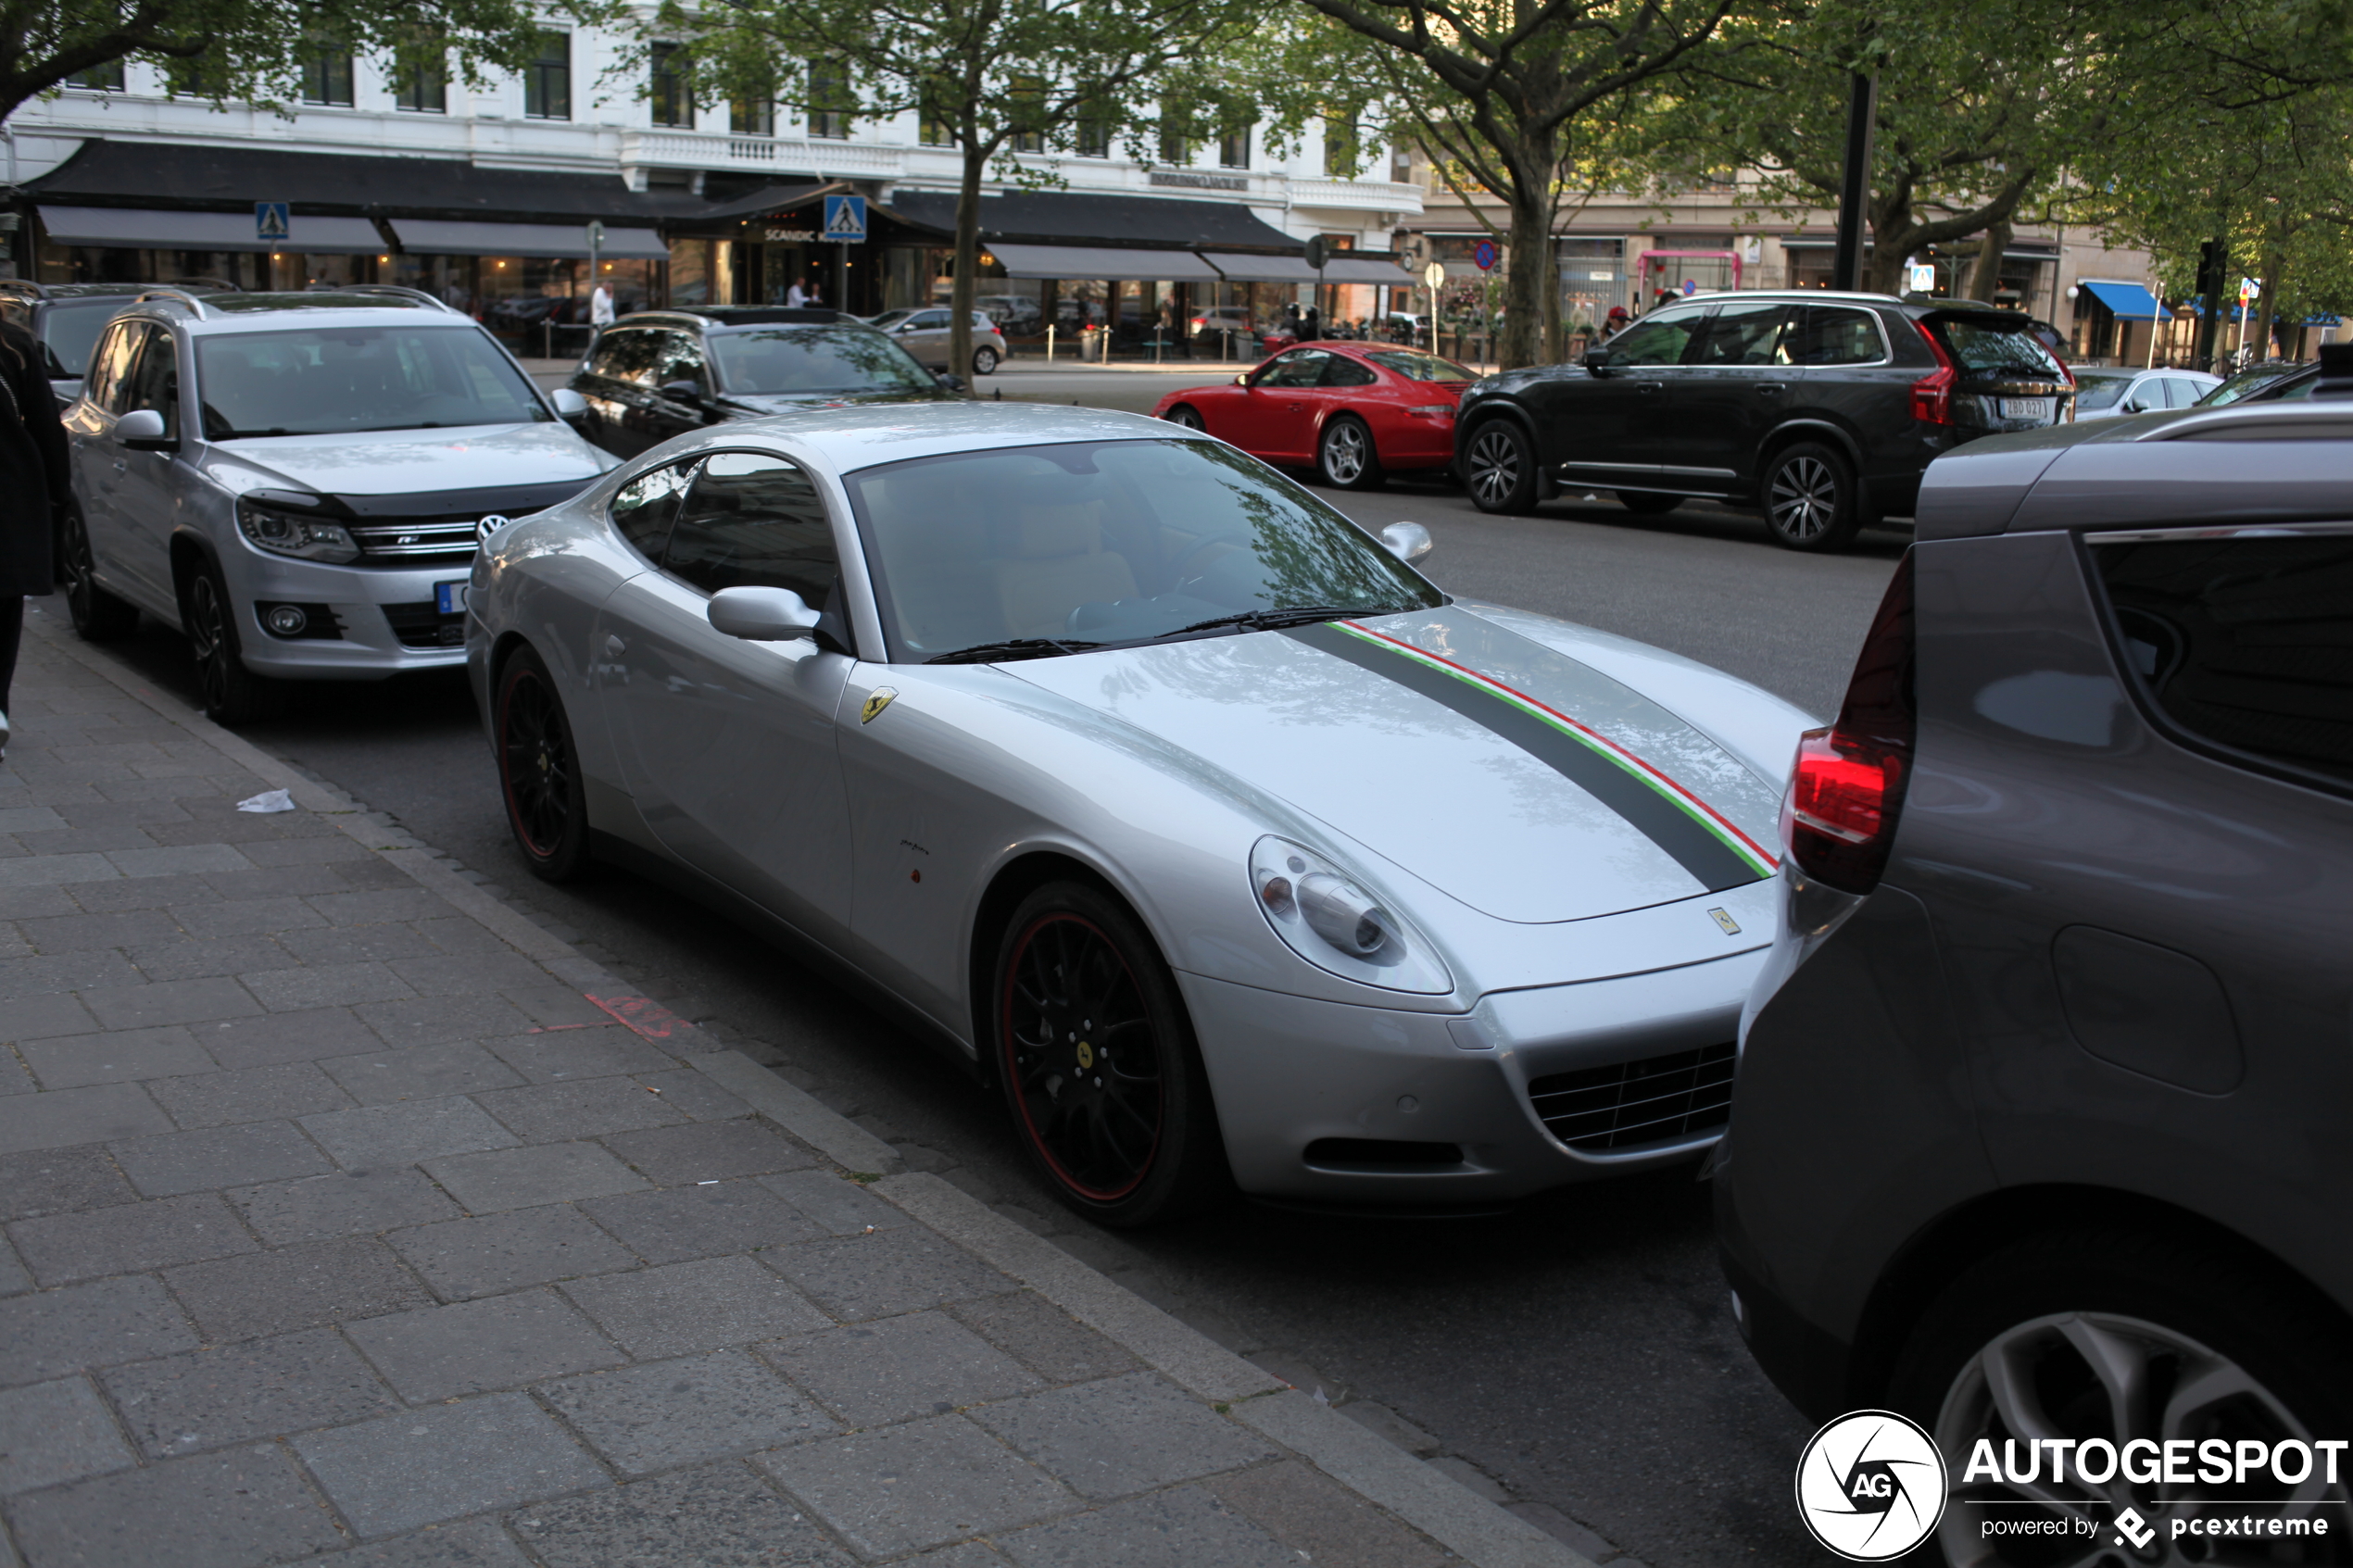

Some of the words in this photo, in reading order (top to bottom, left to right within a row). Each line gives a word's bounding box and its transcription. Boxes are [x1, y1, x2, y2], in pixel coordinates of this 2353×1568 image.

[764, 229, 815, 243] SCANDIC
[2007, 400, 2024, 414] ZBD
[2026, 401, 2042, 415] 027
